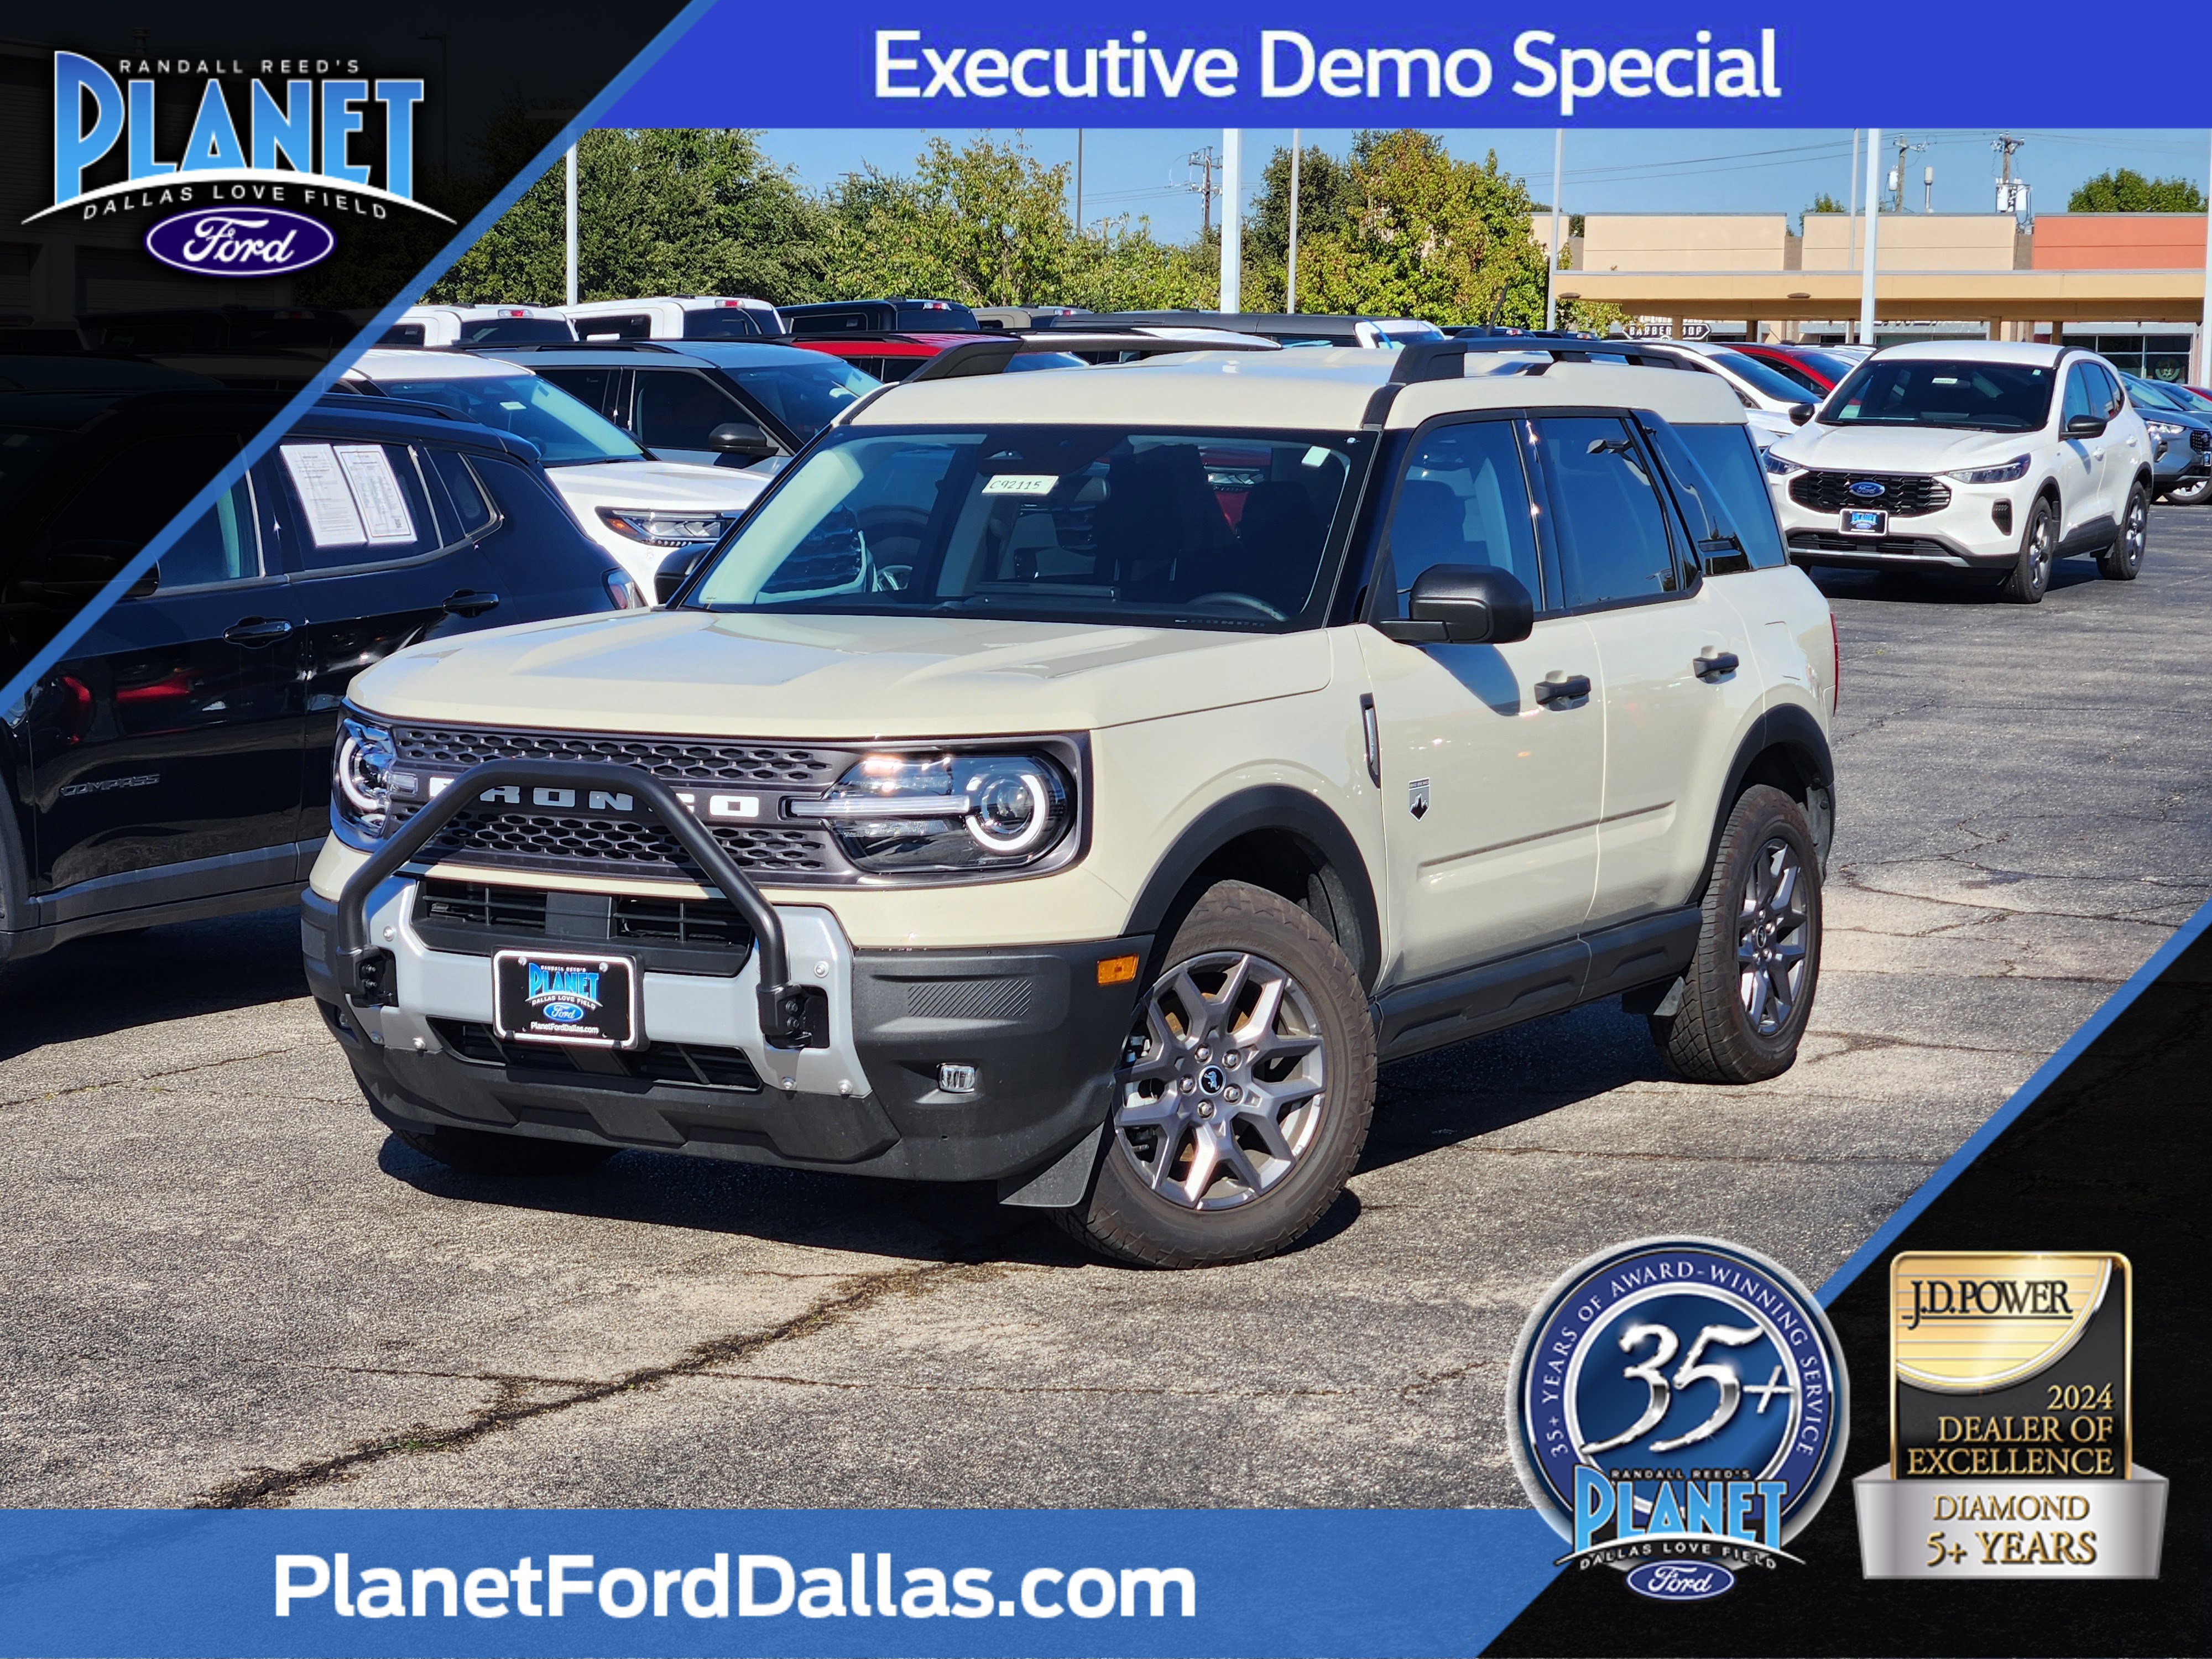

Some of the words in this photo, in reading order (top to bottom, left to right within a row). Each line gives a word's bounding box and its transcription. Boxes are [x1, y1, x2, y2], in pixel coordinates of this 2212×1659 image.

[990, 480, 1042, 489] C92115
[60, 774, 160, 796] COMPASS
[529, 962, 601, 1001] PLANET
[531, 995, 556, 1006] DALLAS
[577, 999, 596, 1009] FIELD
[551, 1004, 576, 1019] Ford
[530, 1021, 599, 1035] PlanetFordDallas.com
